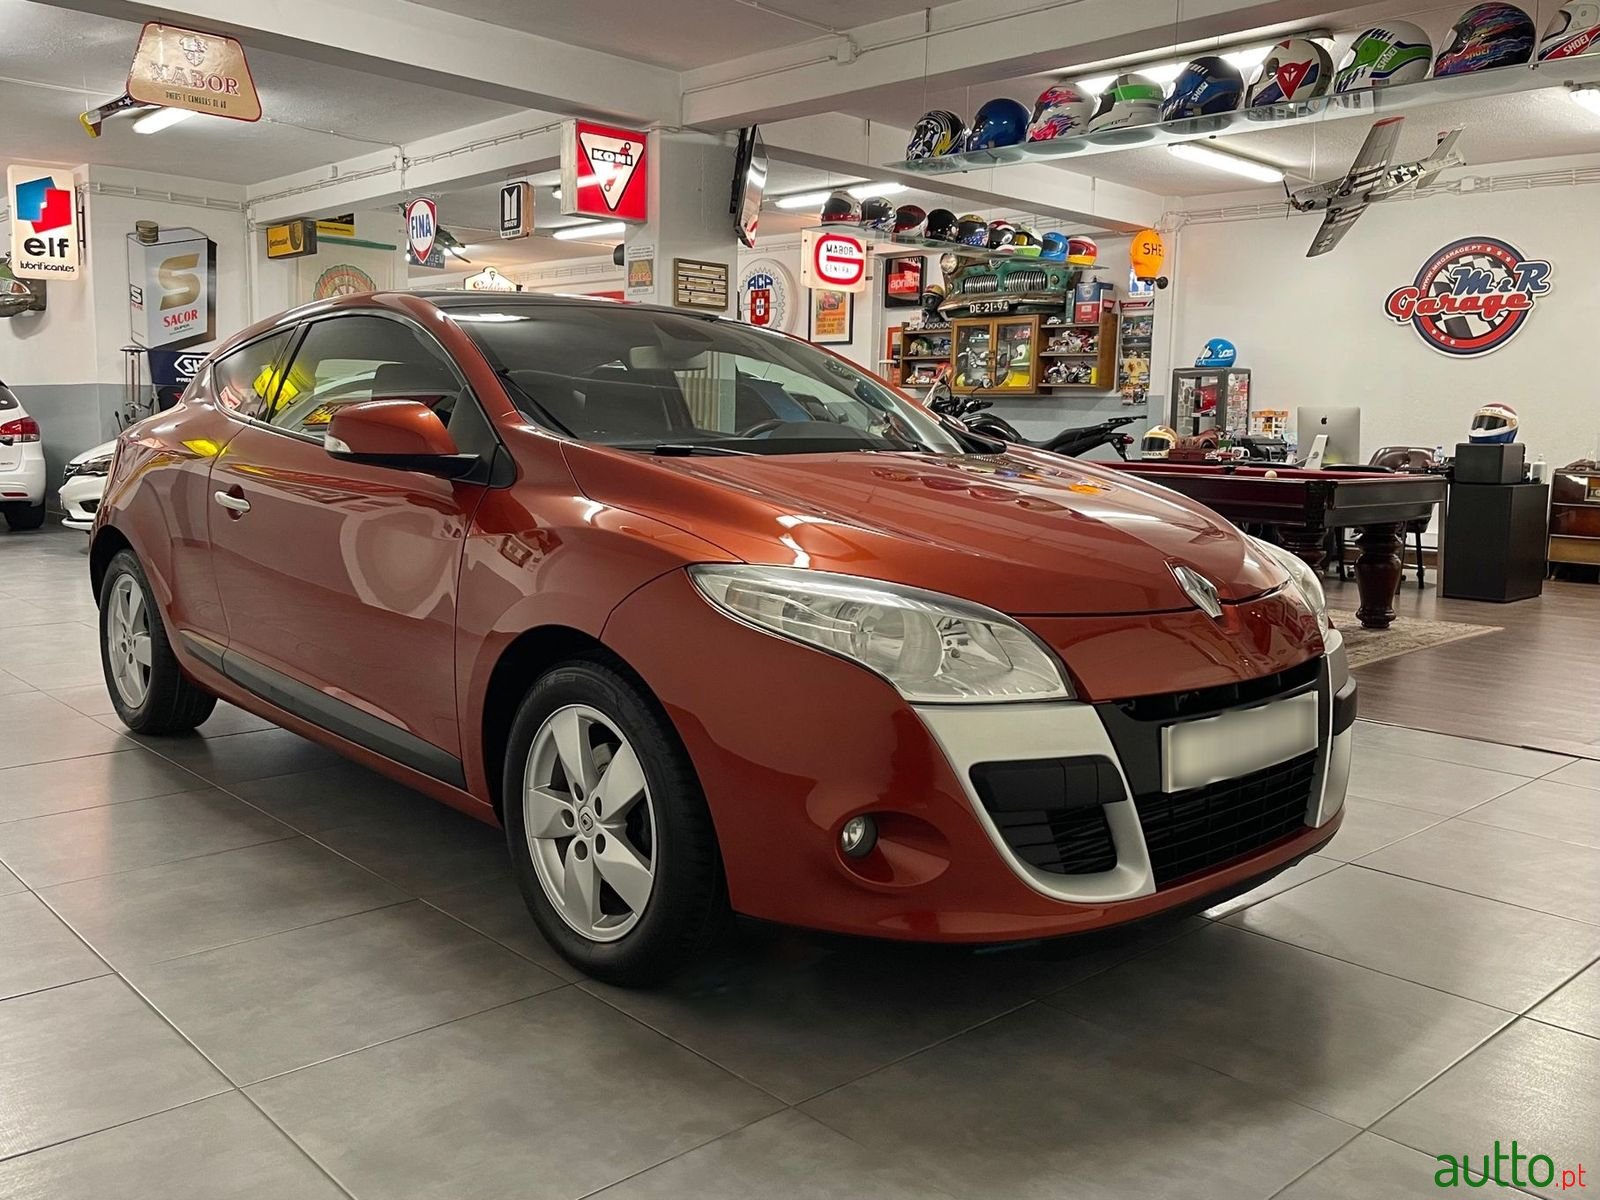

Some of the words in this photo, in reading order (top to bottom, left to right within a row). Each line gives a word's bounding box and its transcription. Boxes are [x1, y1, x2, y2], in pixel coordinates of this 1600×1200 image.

[1563, 34, 1590, 56] SHOEI
[1377, 47, 1398, 71] SHOEI
[150, 63, 241, 96] MABOR
[593, 150, 632, 165] KONI
[411, 214, 432, 240] FINA
[24, 237, 70, 258] elf
[826, 244, 854, 256] MABOR
[20, 261, 76, 273] lubrificantes
[1513, 257, 1551, 294] R
[748, 273, 774, 290] ACP
[970, 303, 1008, 313] DE-21-94
[1388, 288, 1534, 321] Garage
[163, 309, 198, 328] SACOR
